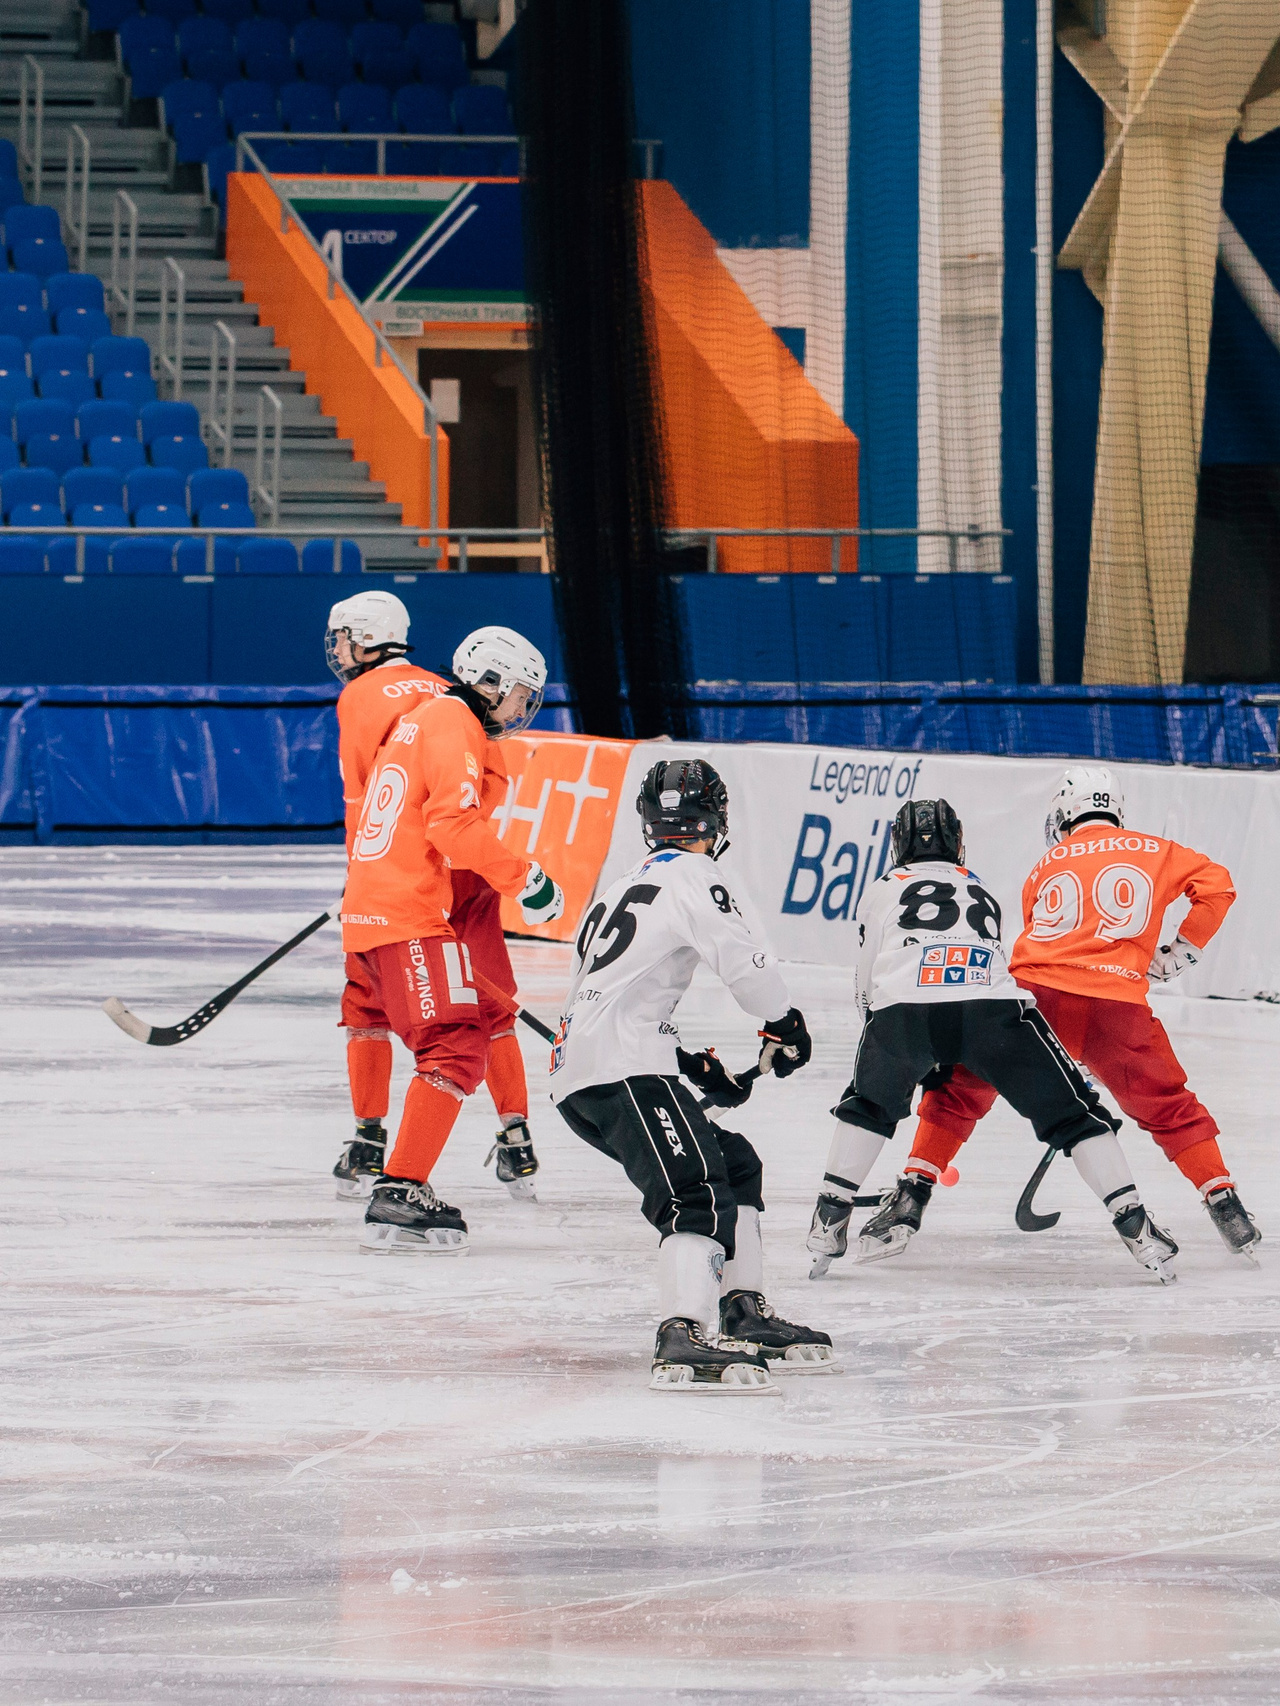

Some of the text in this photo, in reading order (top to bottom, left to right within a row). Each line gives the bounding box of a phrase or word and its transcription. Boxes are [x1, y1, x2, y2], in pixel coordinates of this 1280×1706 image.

[809, 754, 923, 803] Legend of
[1093, 792, 1110, 808] 99
[577, 884, 662, 975] 95
[896, 879, 1002, 941] 88
[1026, 862, 1154, 943] 99
[653, 1107, 687, 1157] STEX
